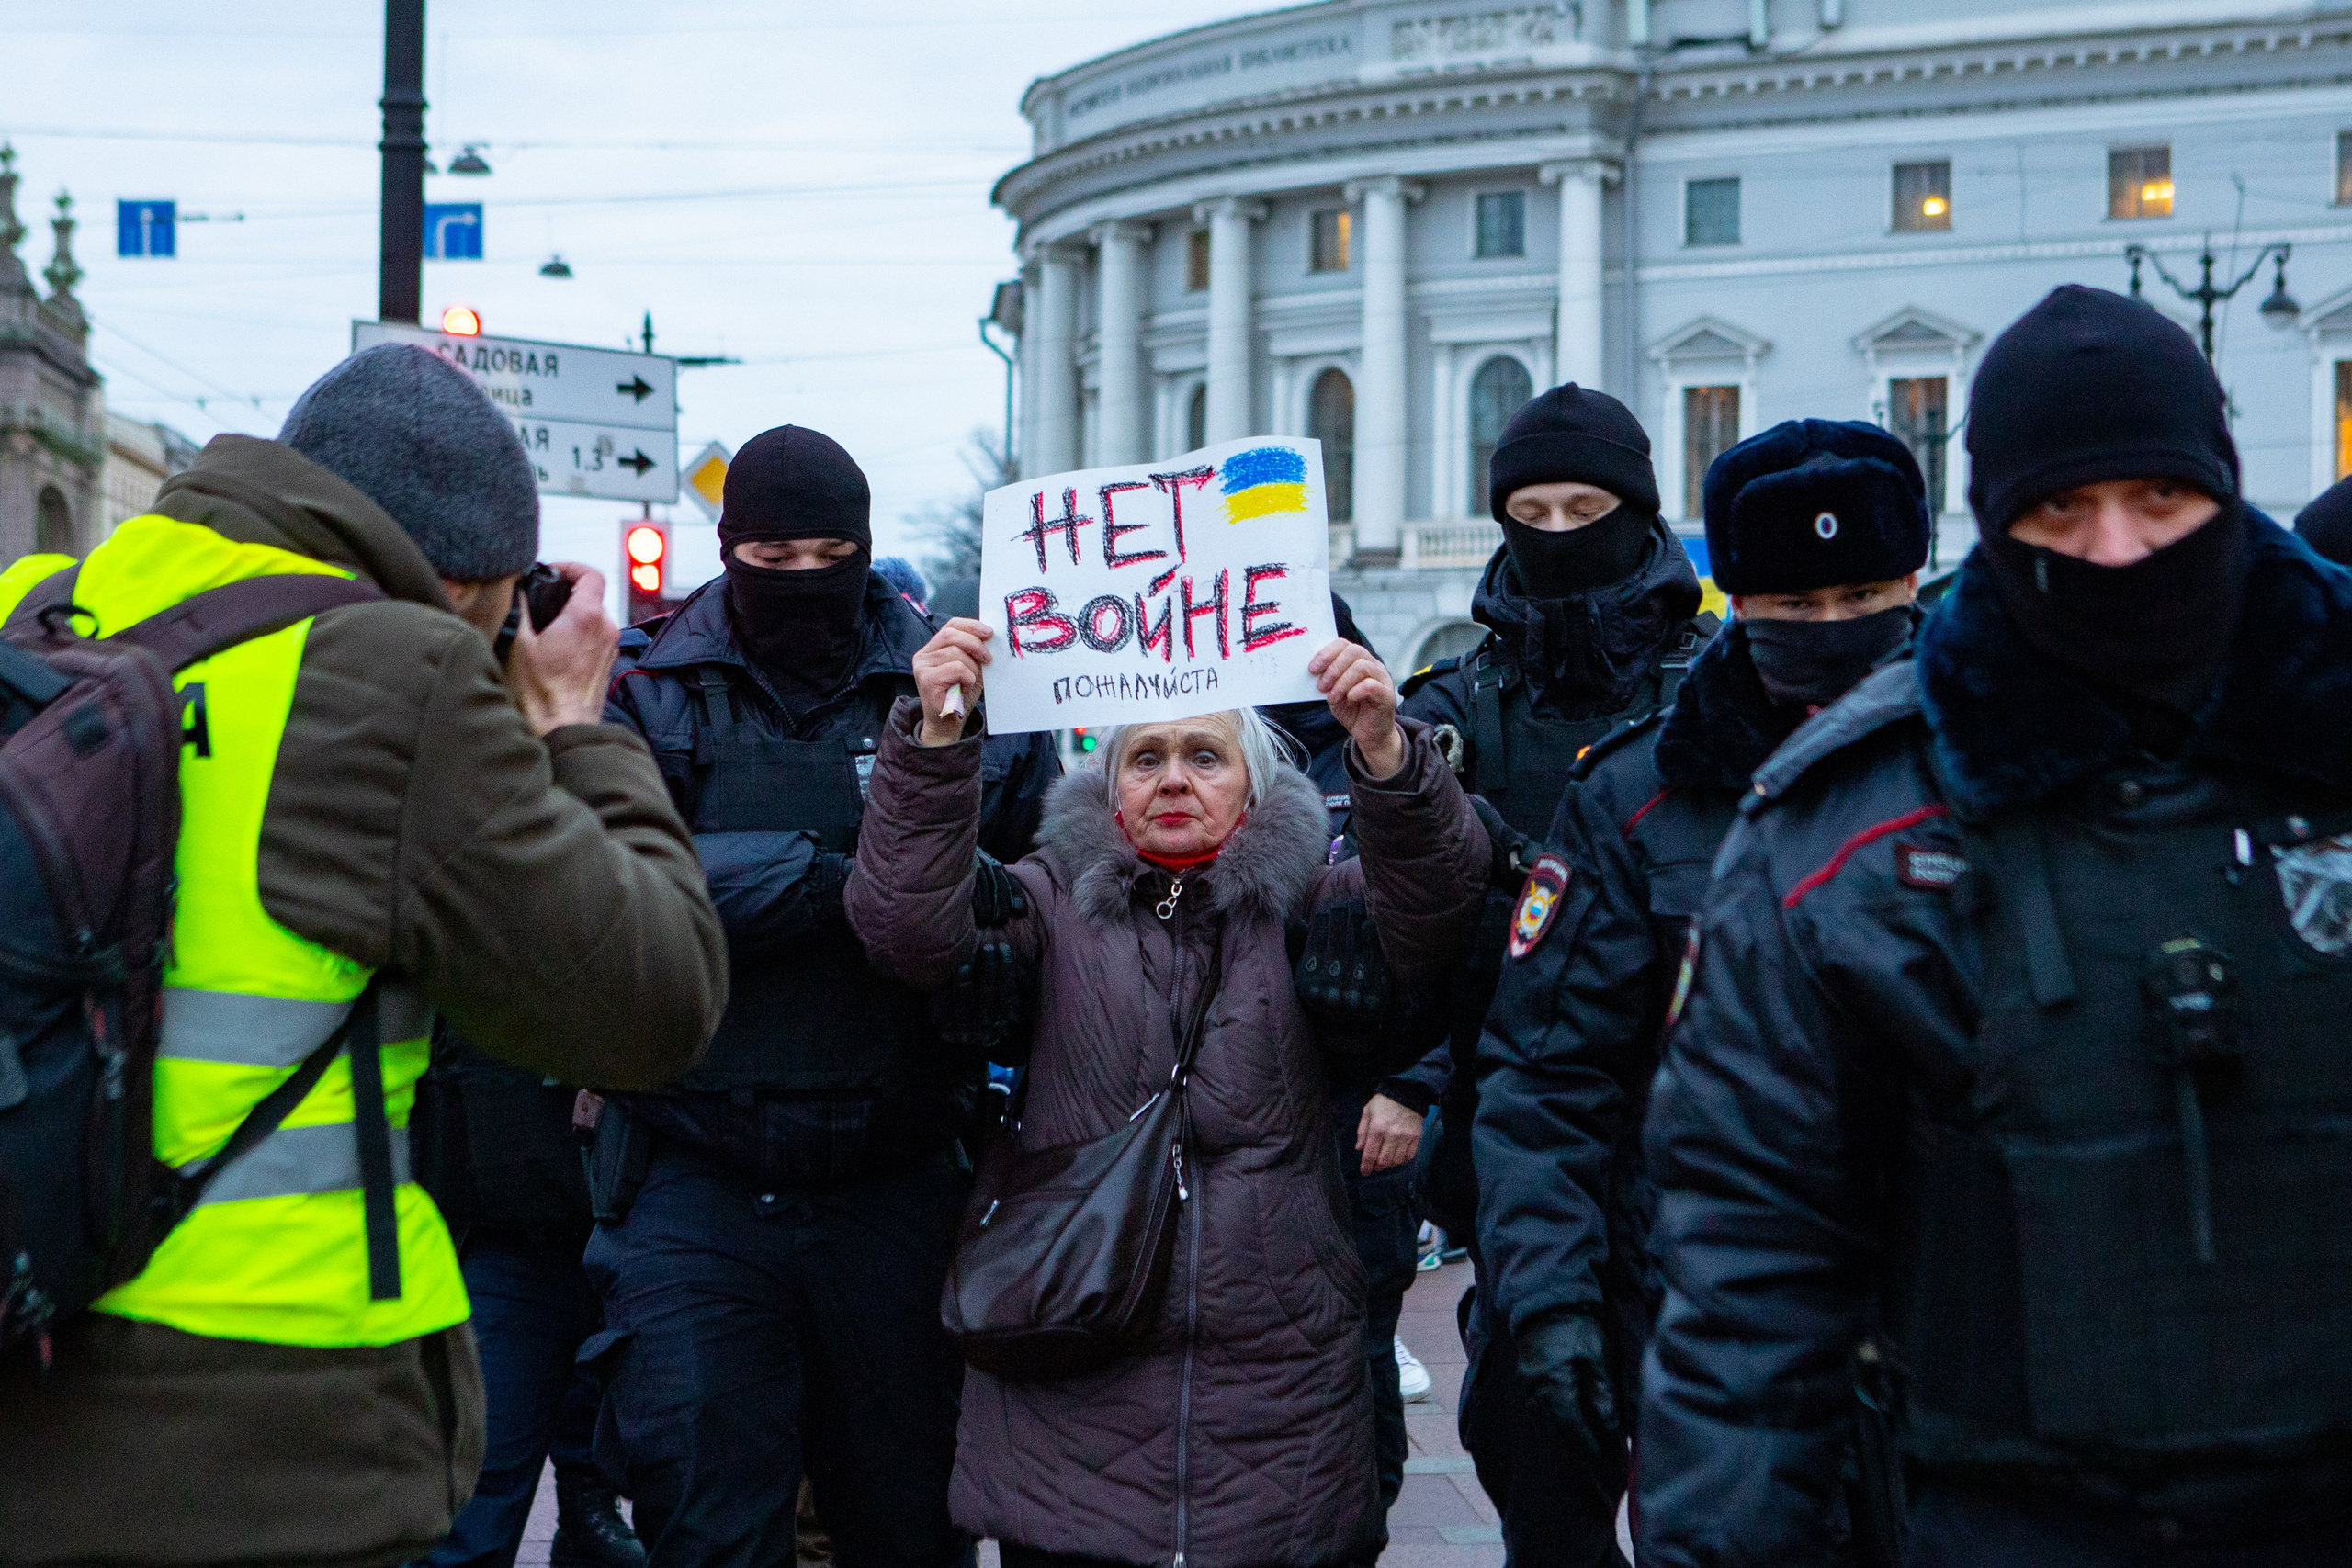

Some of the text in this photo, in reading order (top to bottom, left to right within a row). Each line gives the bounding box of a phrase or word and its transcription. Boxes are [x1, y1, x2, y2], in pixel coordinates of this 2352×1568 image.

[480, 385, 533, 407] ица
[1011, 465, 1218, 574] НЕТ
[1004, 562, 1308, 663] ВОЙНЕ
[1053, 666, 1218, 705] ПОЖАЛУЙСТА
